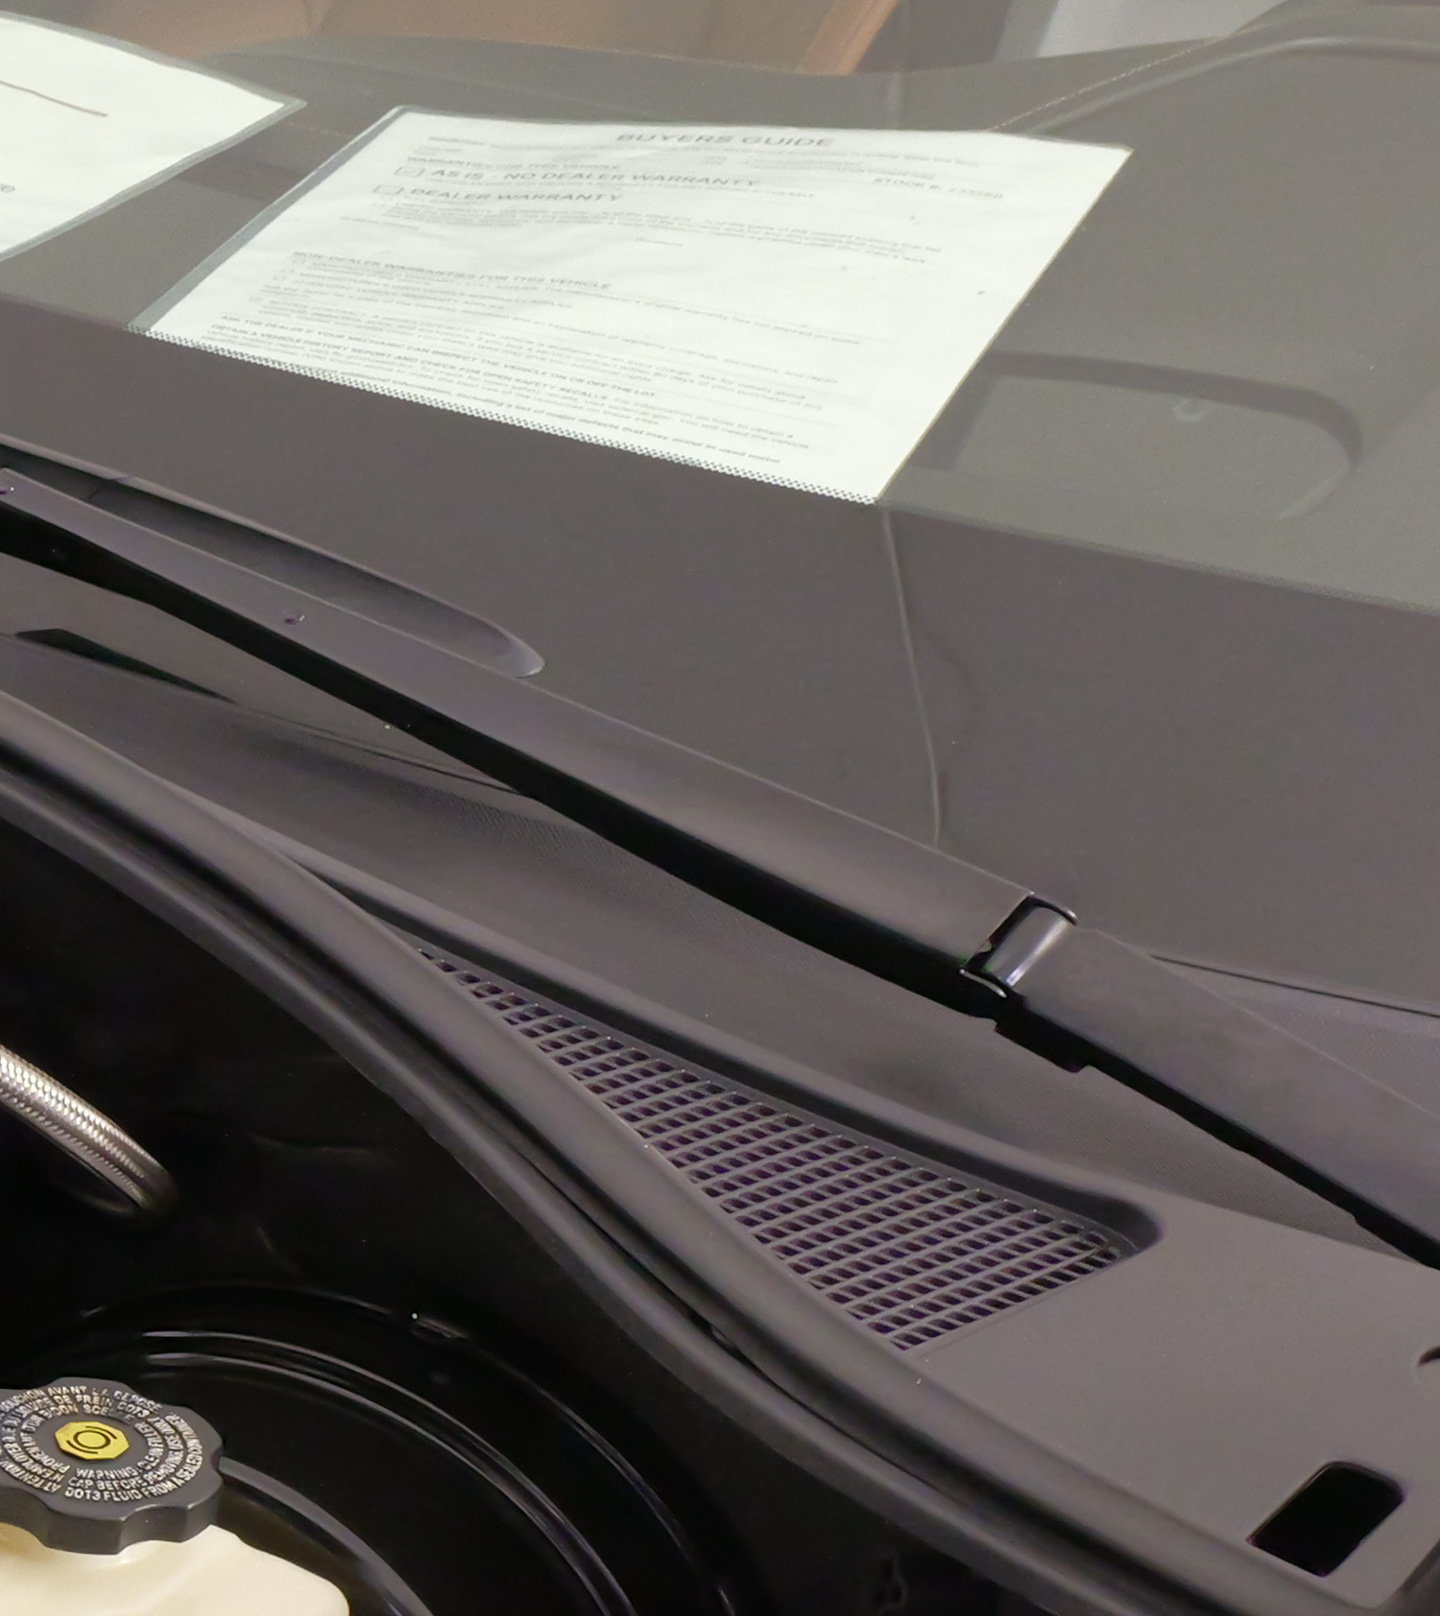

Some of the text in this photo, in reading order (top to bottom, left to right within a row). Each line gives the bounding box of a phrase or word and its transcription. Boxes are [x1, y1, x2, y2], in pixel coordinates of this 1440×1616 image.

[615, 132, 834, 146] BUYERS GUIDE
[429, 168, 462, 178] AS
[539, 172, 627, 180] DEALER
[630, 173, 758, 186] WARRANTY
[408, 188, 622, 201] DEALER WARRANTY
[43, 1384, 88, 1396] AVANT
[50, 1393, 74, 1405] DE
[73, 1394, 115, 1407] FREIN
[65, 1476, 93, 1488] CAP
[94, 1475, 148, 1489] BEFORE
[100, 1488, 146, 1501] FLUID
[137, 1478, 179, 1497] FROM
